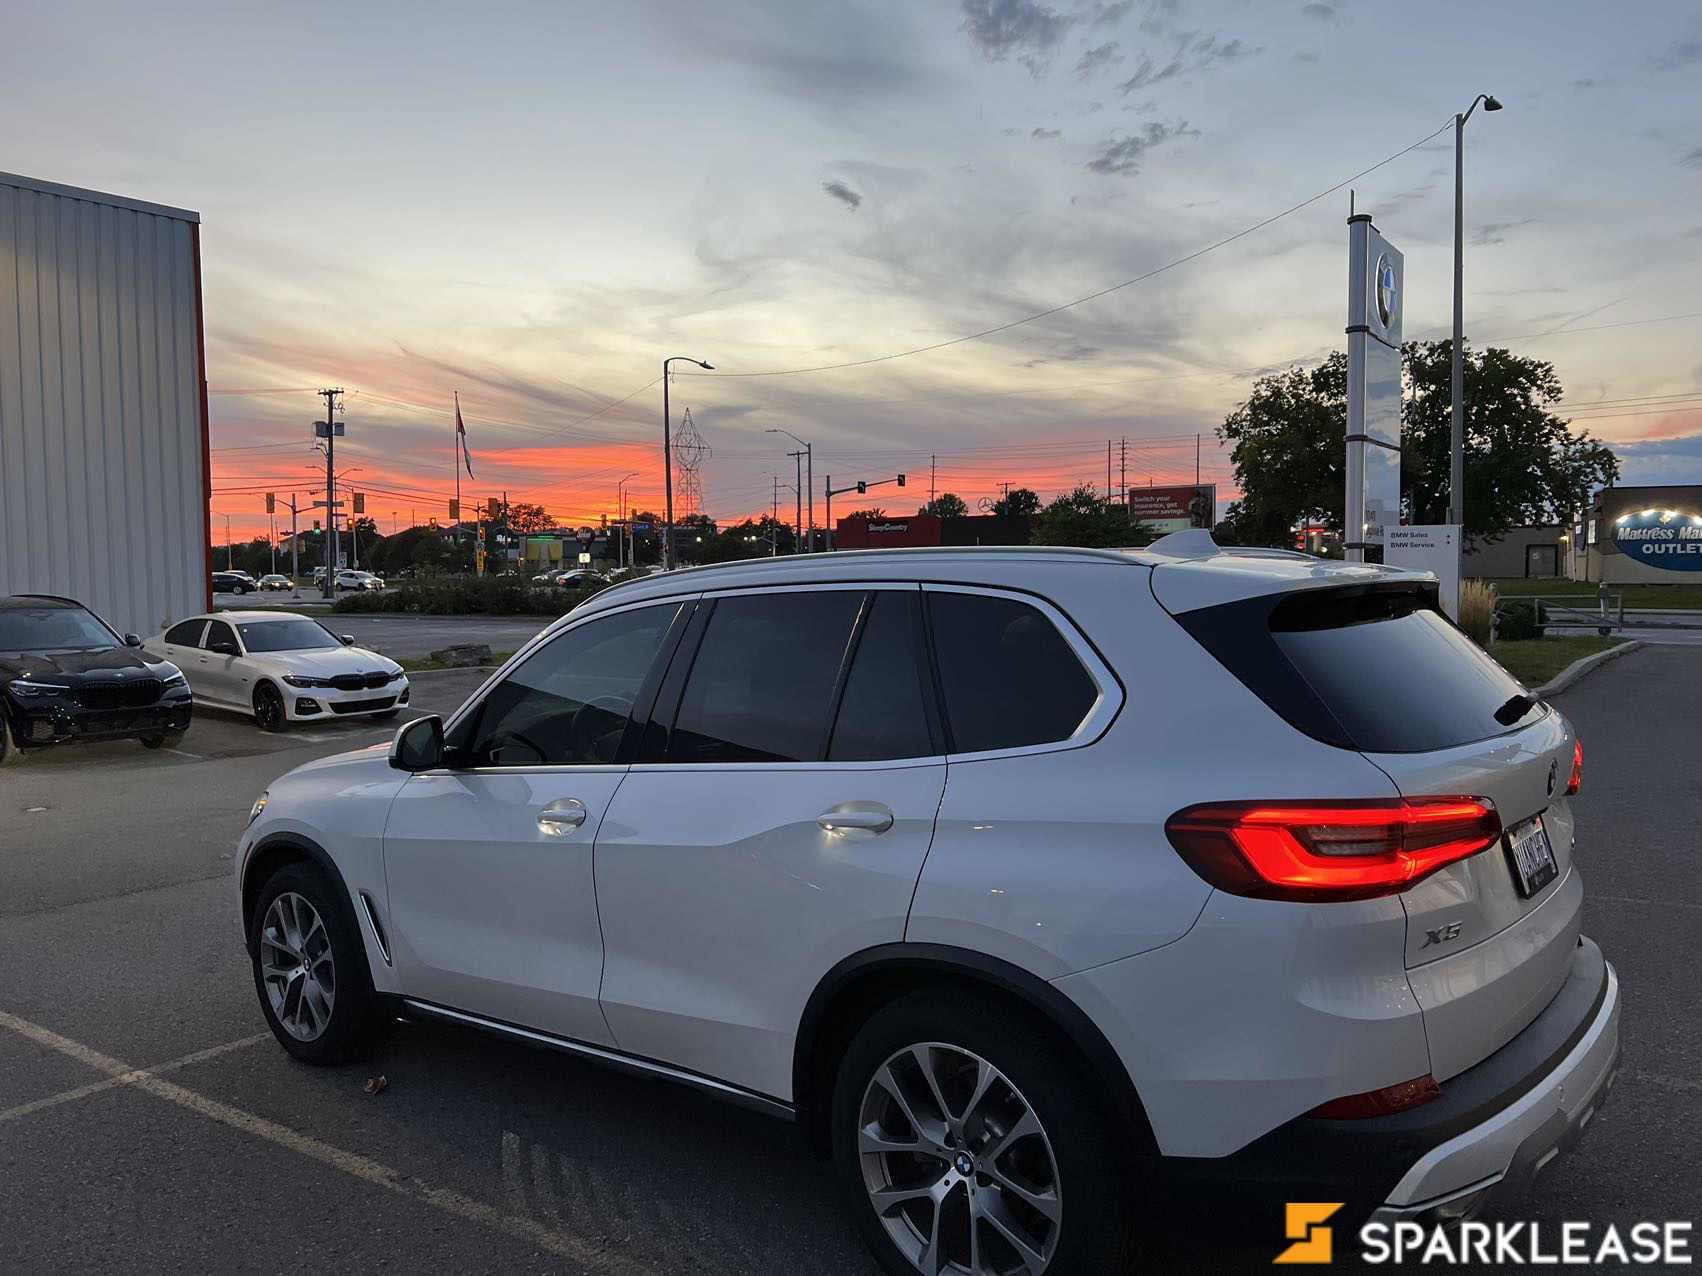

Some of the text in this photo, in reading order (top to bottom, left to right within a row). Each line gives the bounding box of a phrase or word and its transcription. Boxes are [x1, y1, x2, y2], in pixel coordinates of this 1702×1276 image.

[1617, 527, 1675, 540] Mattress
[1642, 543, 1702, 554] OUTLET
[1422, 922, 1462, 948] X5
